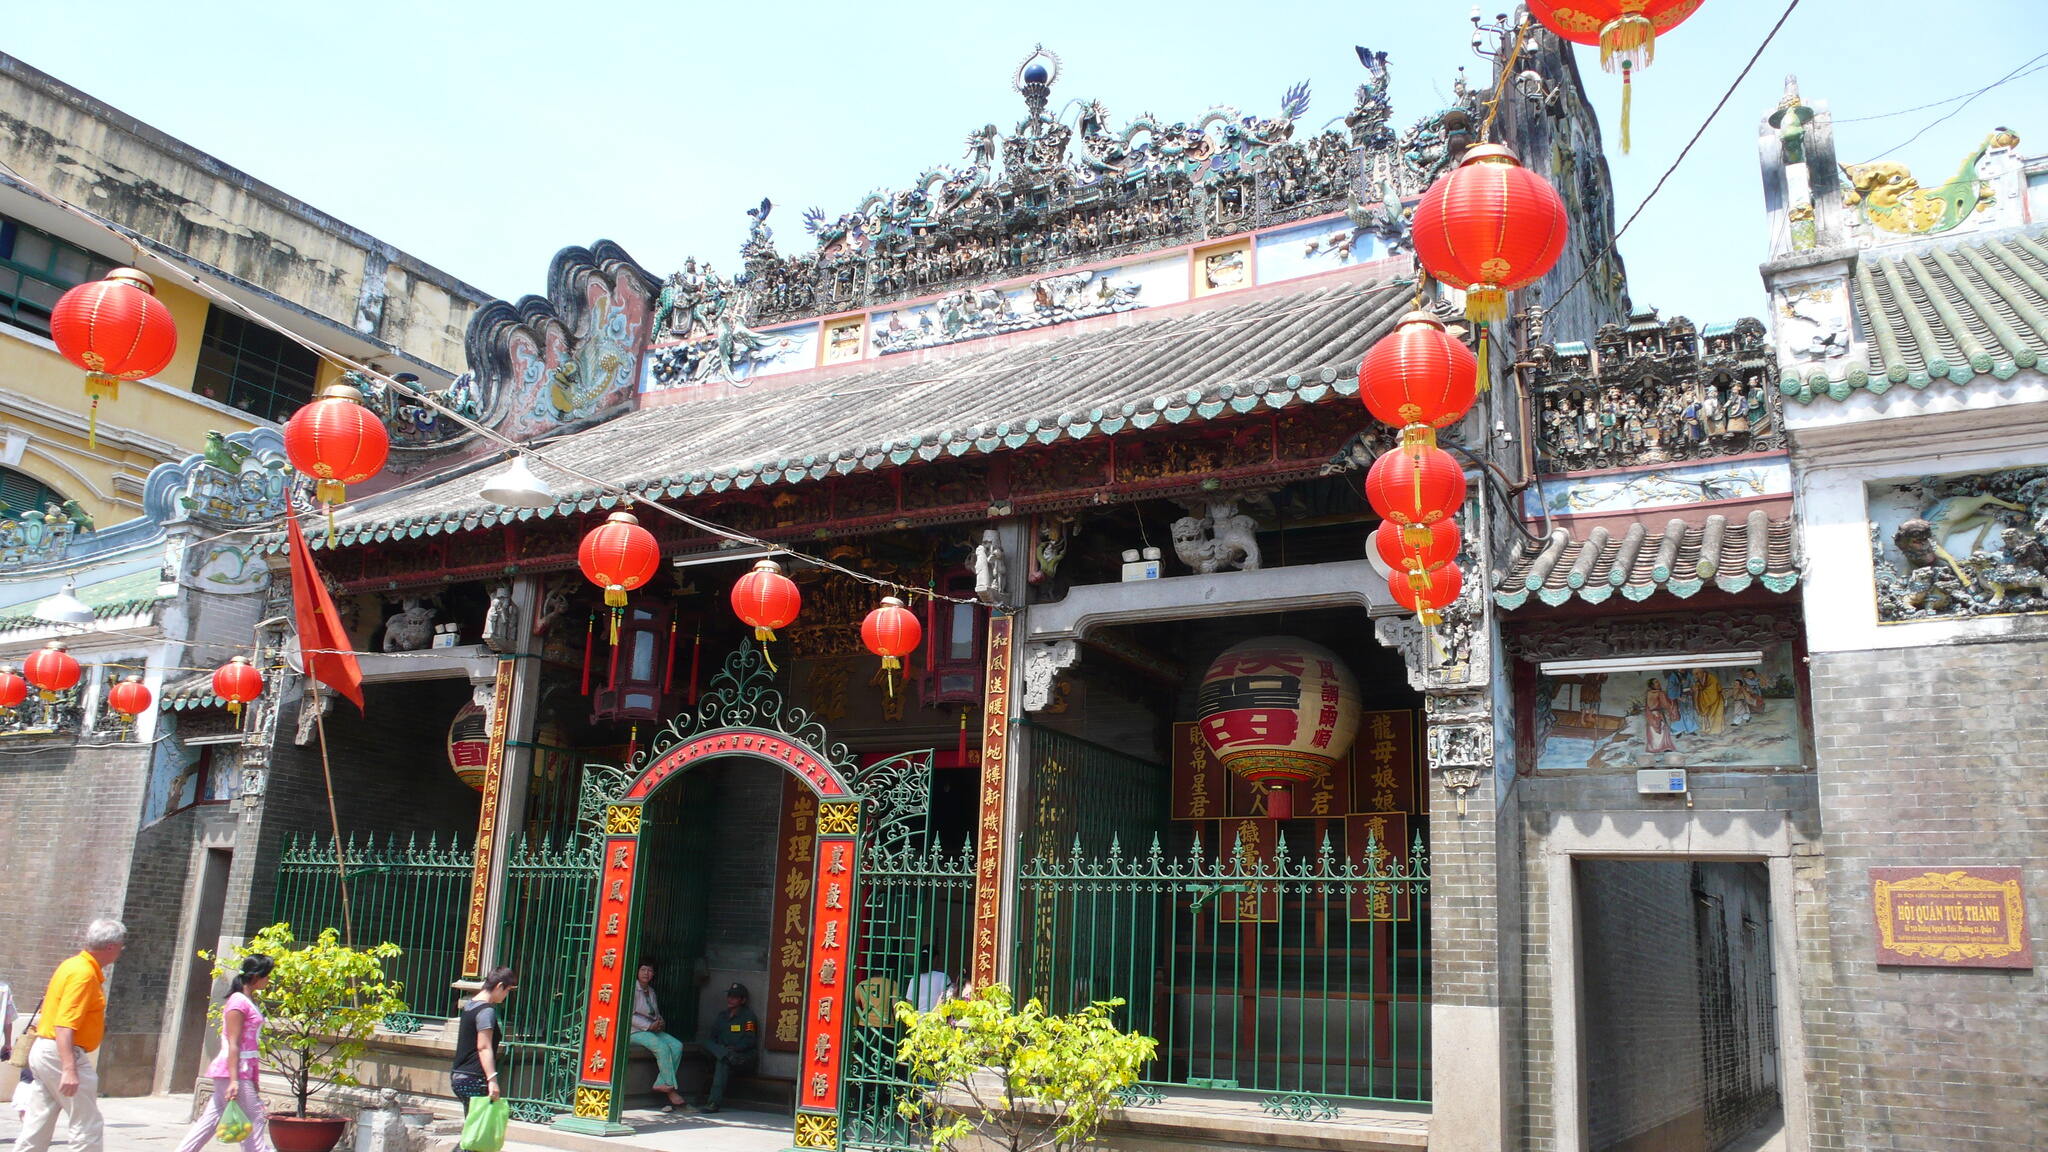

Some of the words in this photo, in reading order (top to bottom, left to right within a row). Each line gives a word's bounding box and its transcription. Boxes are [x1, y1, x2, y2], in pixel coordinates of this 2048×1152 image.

[1310, 659, 1340, 749] 風調雨順
[1369, 713, 1400, 812] 龍母娘娘
[1898, 901, 1915, 924] HỘI
[1916, 901, 1944, 924] QUÁN
[1944, 901, 1964, 924] TUỆ
[1965, 901, 2000, 922] THÀNH
